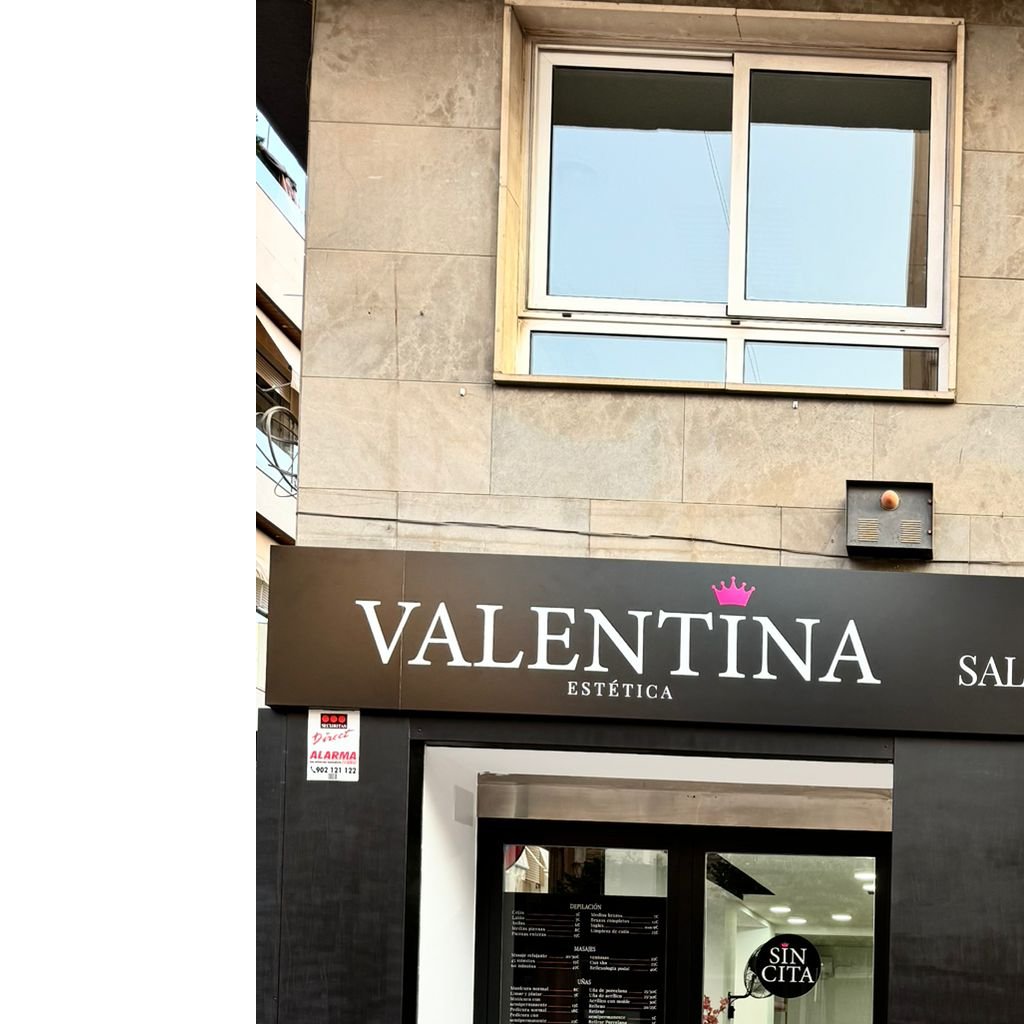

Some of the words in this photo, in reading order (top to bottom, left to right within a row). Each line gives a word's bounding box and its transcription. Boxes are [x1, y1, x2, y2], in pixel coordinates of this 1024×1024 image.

[355, 600, 881, 685] VALENTINA
[567, 679, 673, 700] ESTÉTICA
[312, 729, 355, 745] Direct
[309, 750, 357, 760] ALARMA
[769, 947, 807, 965] SIN
[761, 965, 815, 983] CITA
